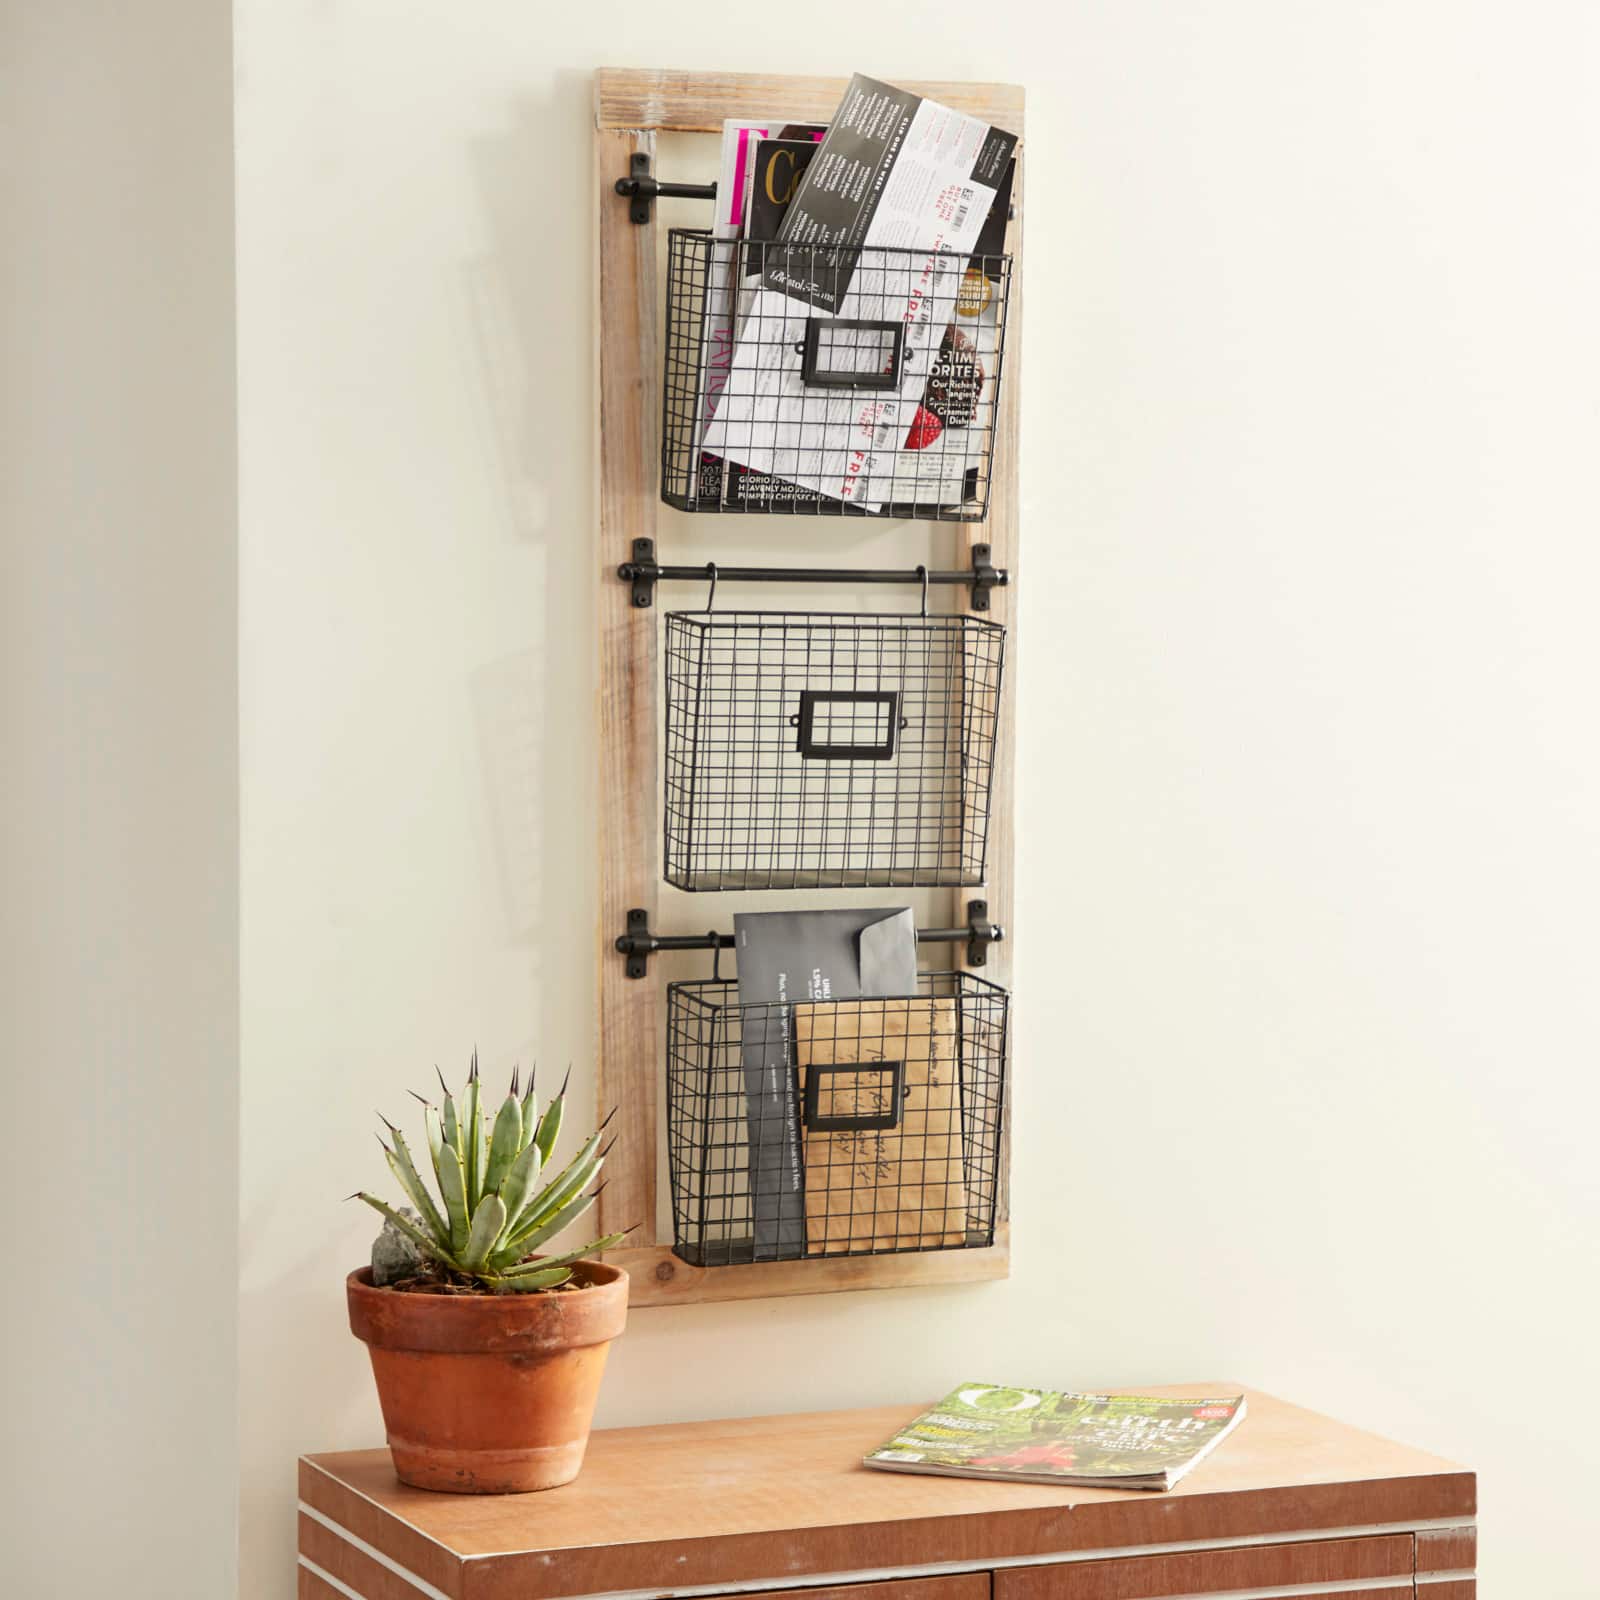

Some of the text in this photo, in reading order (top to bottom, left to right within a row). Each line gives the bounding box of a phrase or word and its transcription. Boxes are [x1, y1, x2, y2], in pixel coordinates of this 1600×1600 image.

[873, 117, 908, 190] CLIP ONE PER WEEK
[839, 450, 866, 496] FREE
[786, 1103, 795, 1129] forign
[789, 1131, 798, 1173] trasactin
